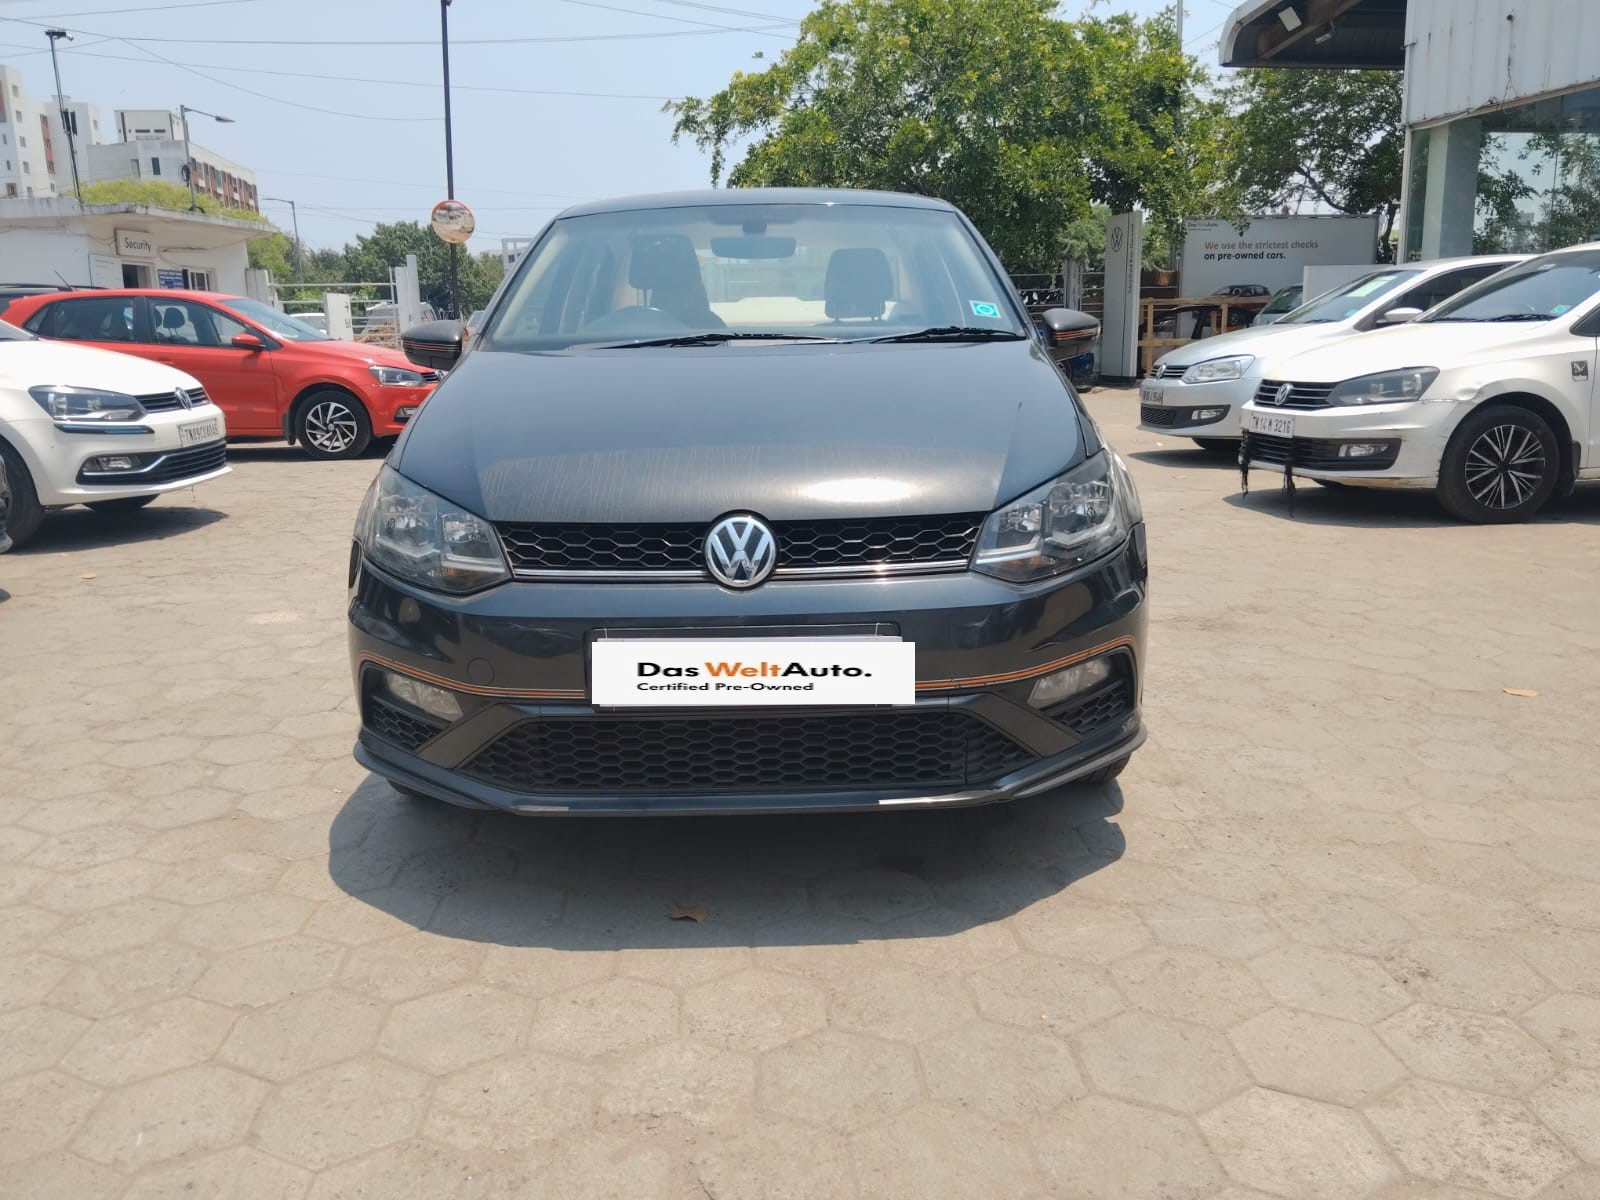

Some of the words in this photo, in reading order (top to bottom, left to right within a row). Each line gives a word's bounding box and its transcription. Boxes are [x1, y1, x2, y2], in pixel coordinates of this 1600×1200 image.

[124, 237, 152, 254] Security
[1204, 241, 1219, 250] We
[1221, 242, 1236, 250] use
[1238, 241, 1253, 250] the
[1254, 240, 1289, 250] strictest
[1291, 239, 1319, 249] checks
[1203, 252, 1215, 260] on
[1217, 251, 1264, 261] pre-owned
[1266, 252, 1287, 260] cars.
